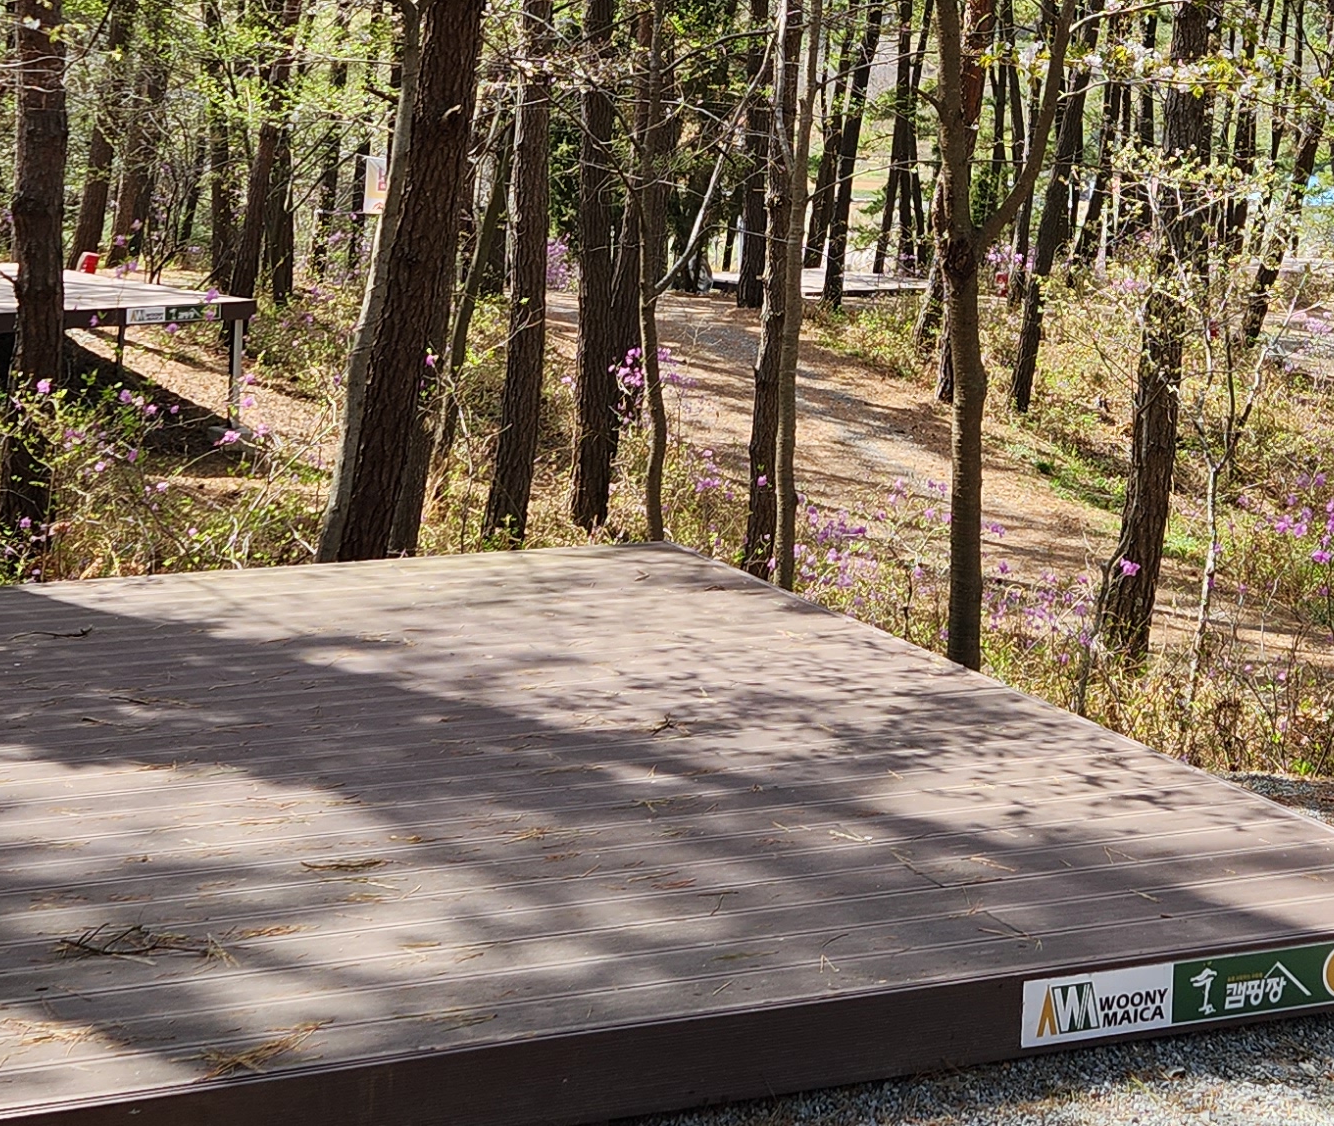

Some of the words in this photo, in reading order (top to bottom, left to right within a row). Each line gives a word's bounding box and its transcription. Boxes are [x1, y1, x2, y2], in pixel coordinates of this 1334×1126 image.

[1099, 987, 1169, 1012] WOONY
[1224, 975, 1288, 1010] 캠핑장
[1102, 1005, 1165, 1028] MAICA
